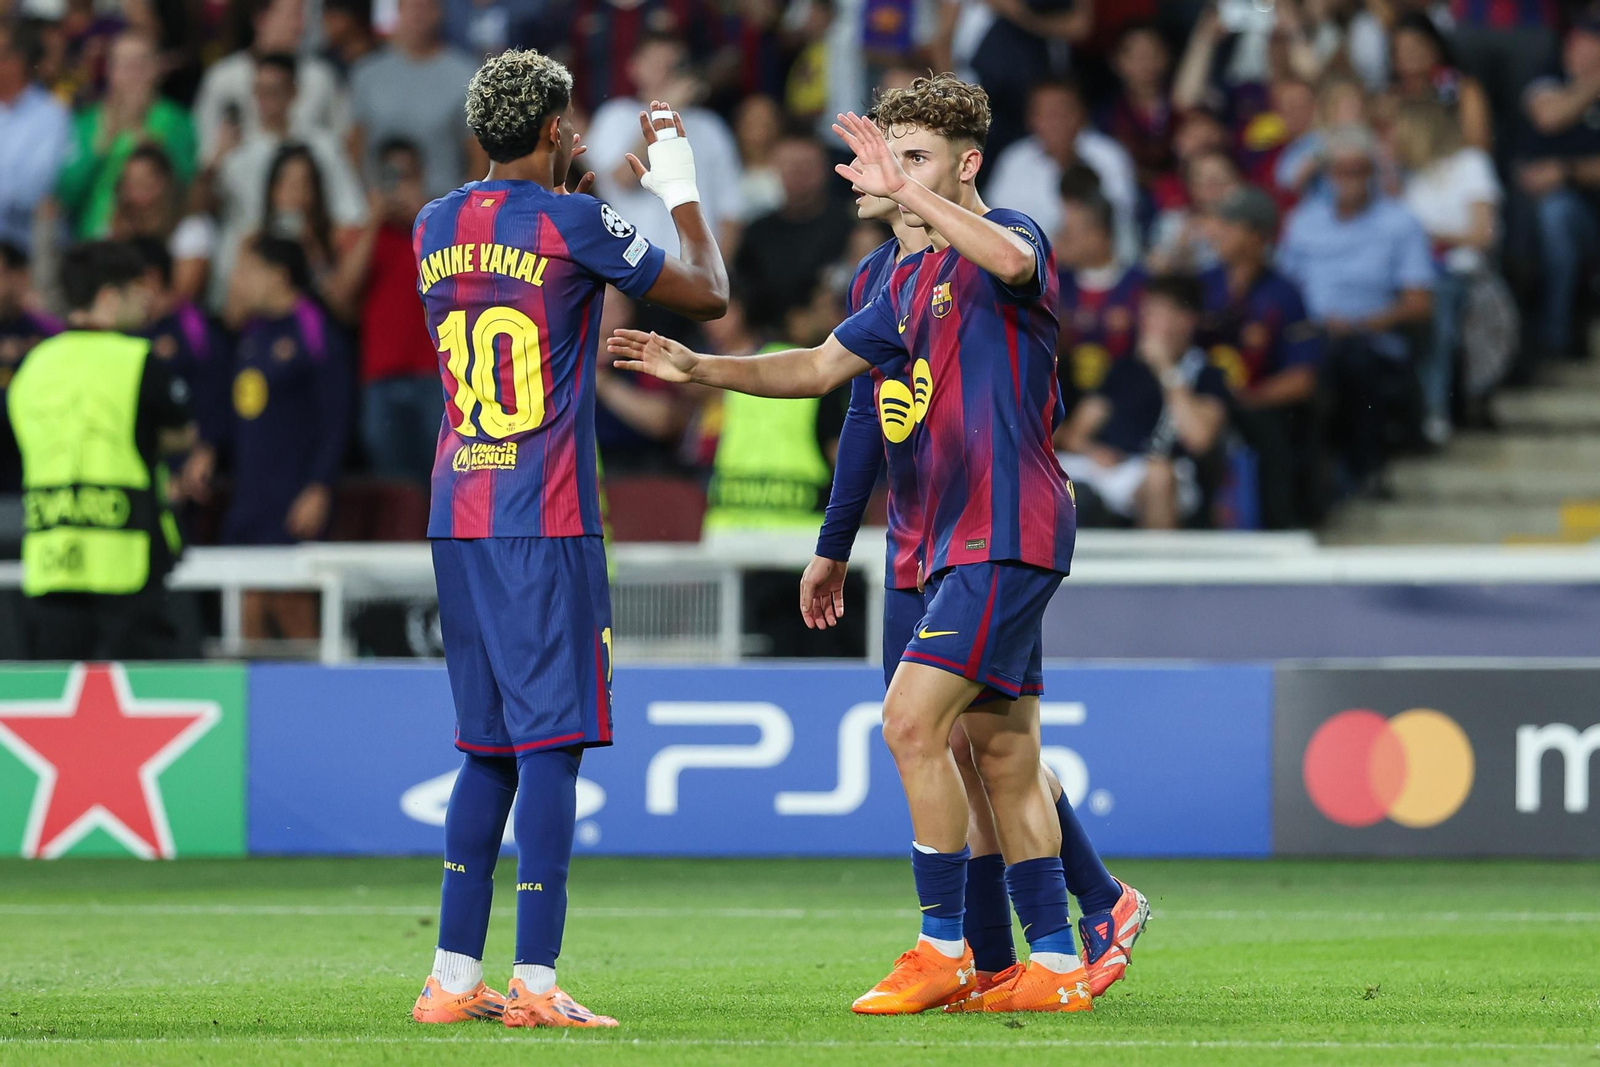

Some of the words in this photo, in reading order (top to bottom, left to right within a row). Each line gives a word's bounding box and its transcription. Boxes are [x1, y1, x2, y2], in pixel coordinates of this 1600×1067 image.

[479, 243, 549, 287] YAMAL
[436, 306, 545, 439] 10
[471, 453, 517, 465] ACNUR
[602, 627, 612, 682] 1
